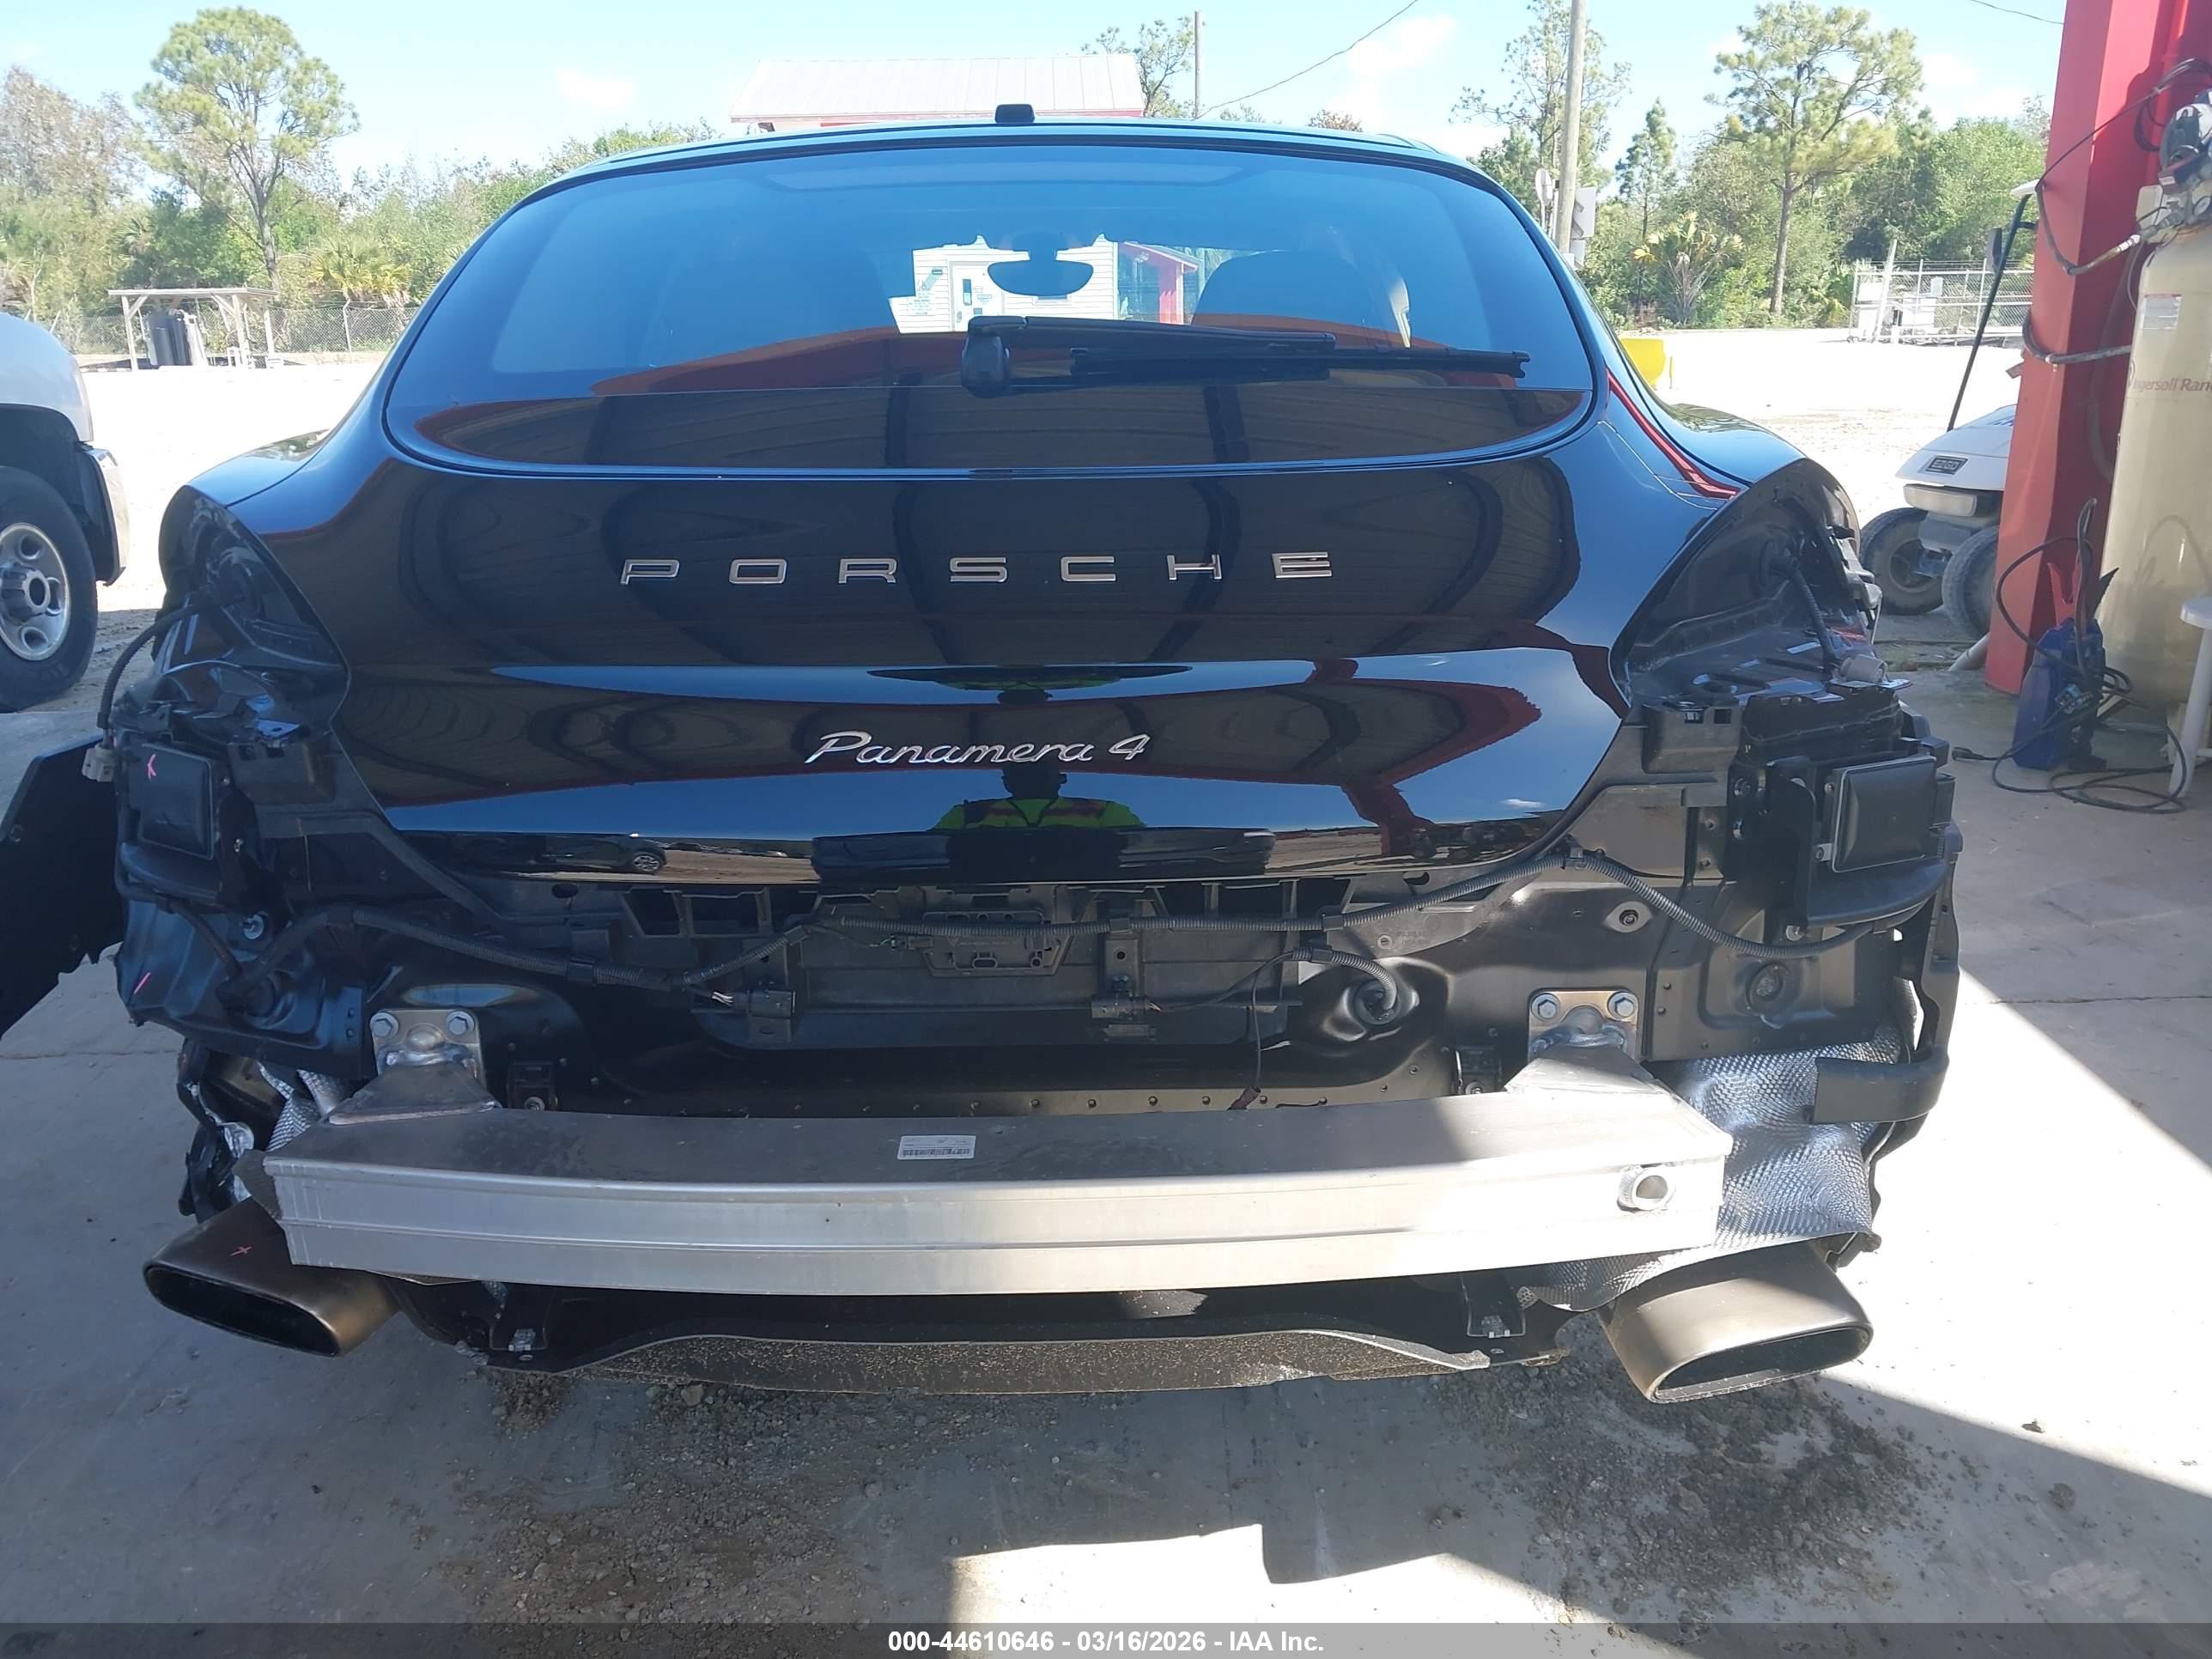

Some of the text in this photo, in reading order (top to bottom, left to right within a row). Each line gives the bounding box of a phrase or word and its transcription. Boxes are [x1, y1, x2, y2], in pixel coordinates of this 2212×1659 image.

[2180, 378, 2212, 392] Ran
[619, 552, 1333, 585] PORSCHE
[805, 730, 1151, 763] Panamera 4
